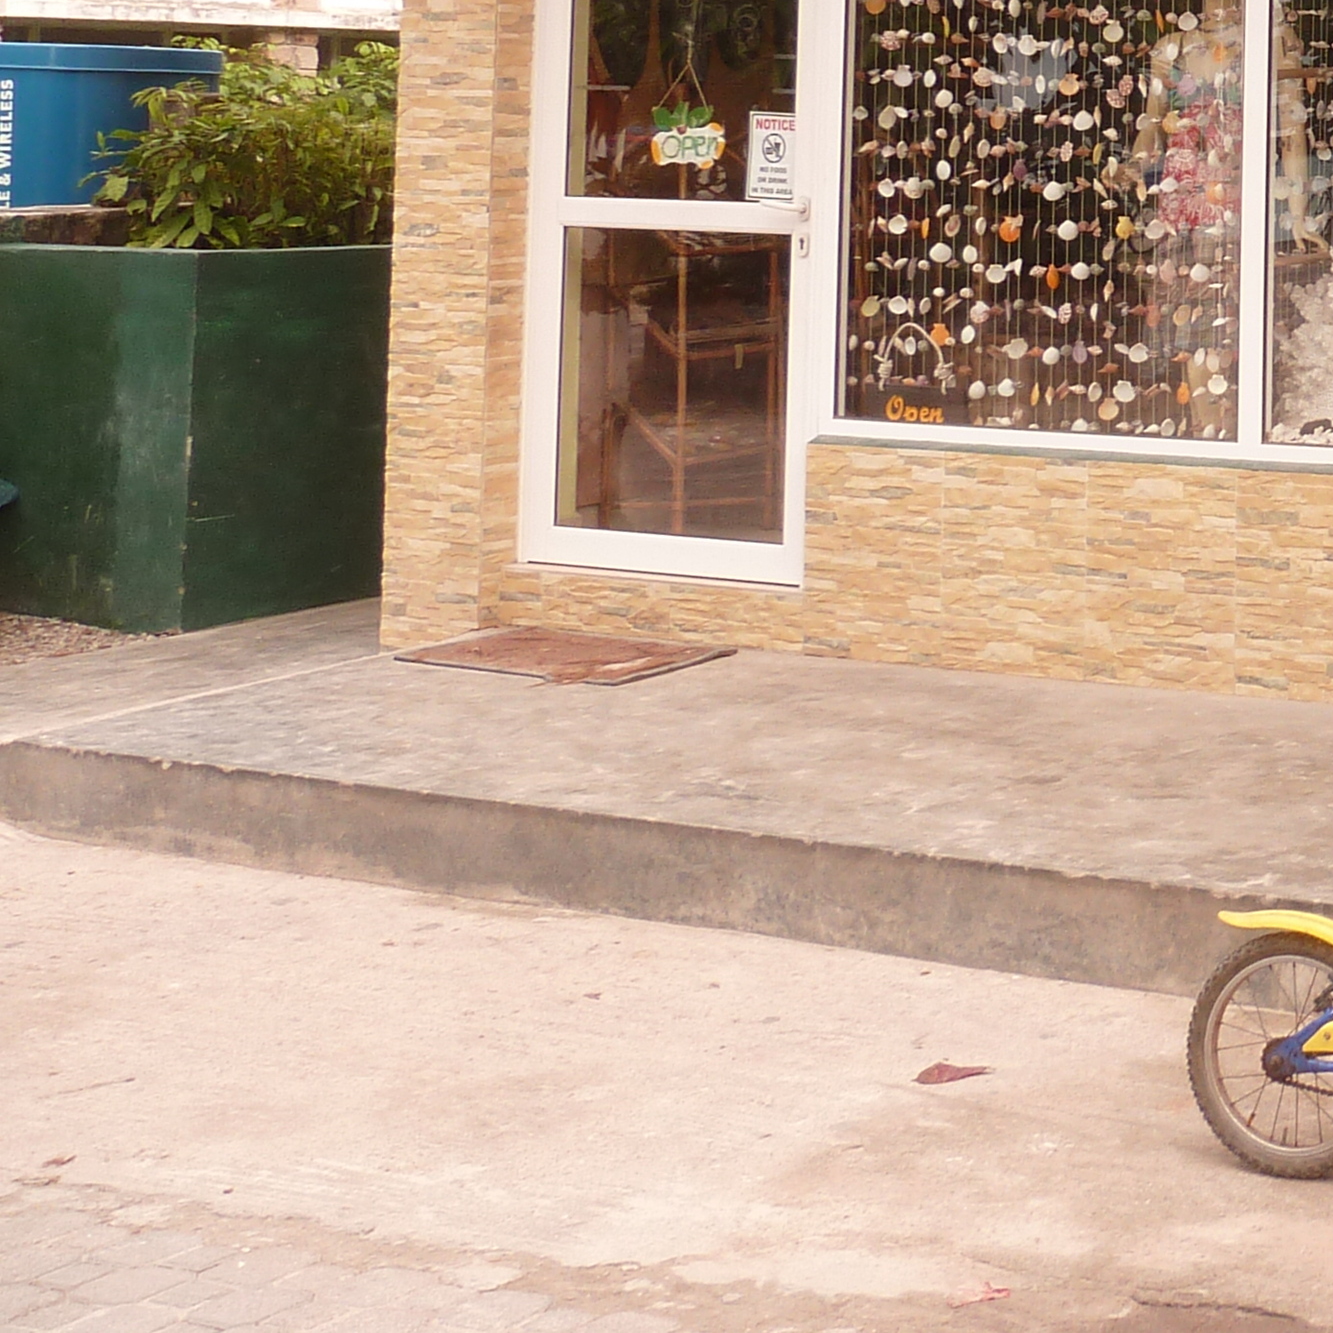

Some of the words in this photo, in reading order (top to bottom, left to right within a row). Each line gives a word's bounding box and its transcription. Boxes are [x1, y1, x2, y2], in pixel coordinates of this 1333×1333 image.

[0, 79, 14, 168] WIRELESS
[755, 118, 795, 131] NOTICE
[886, 395, 944, 423] Open
